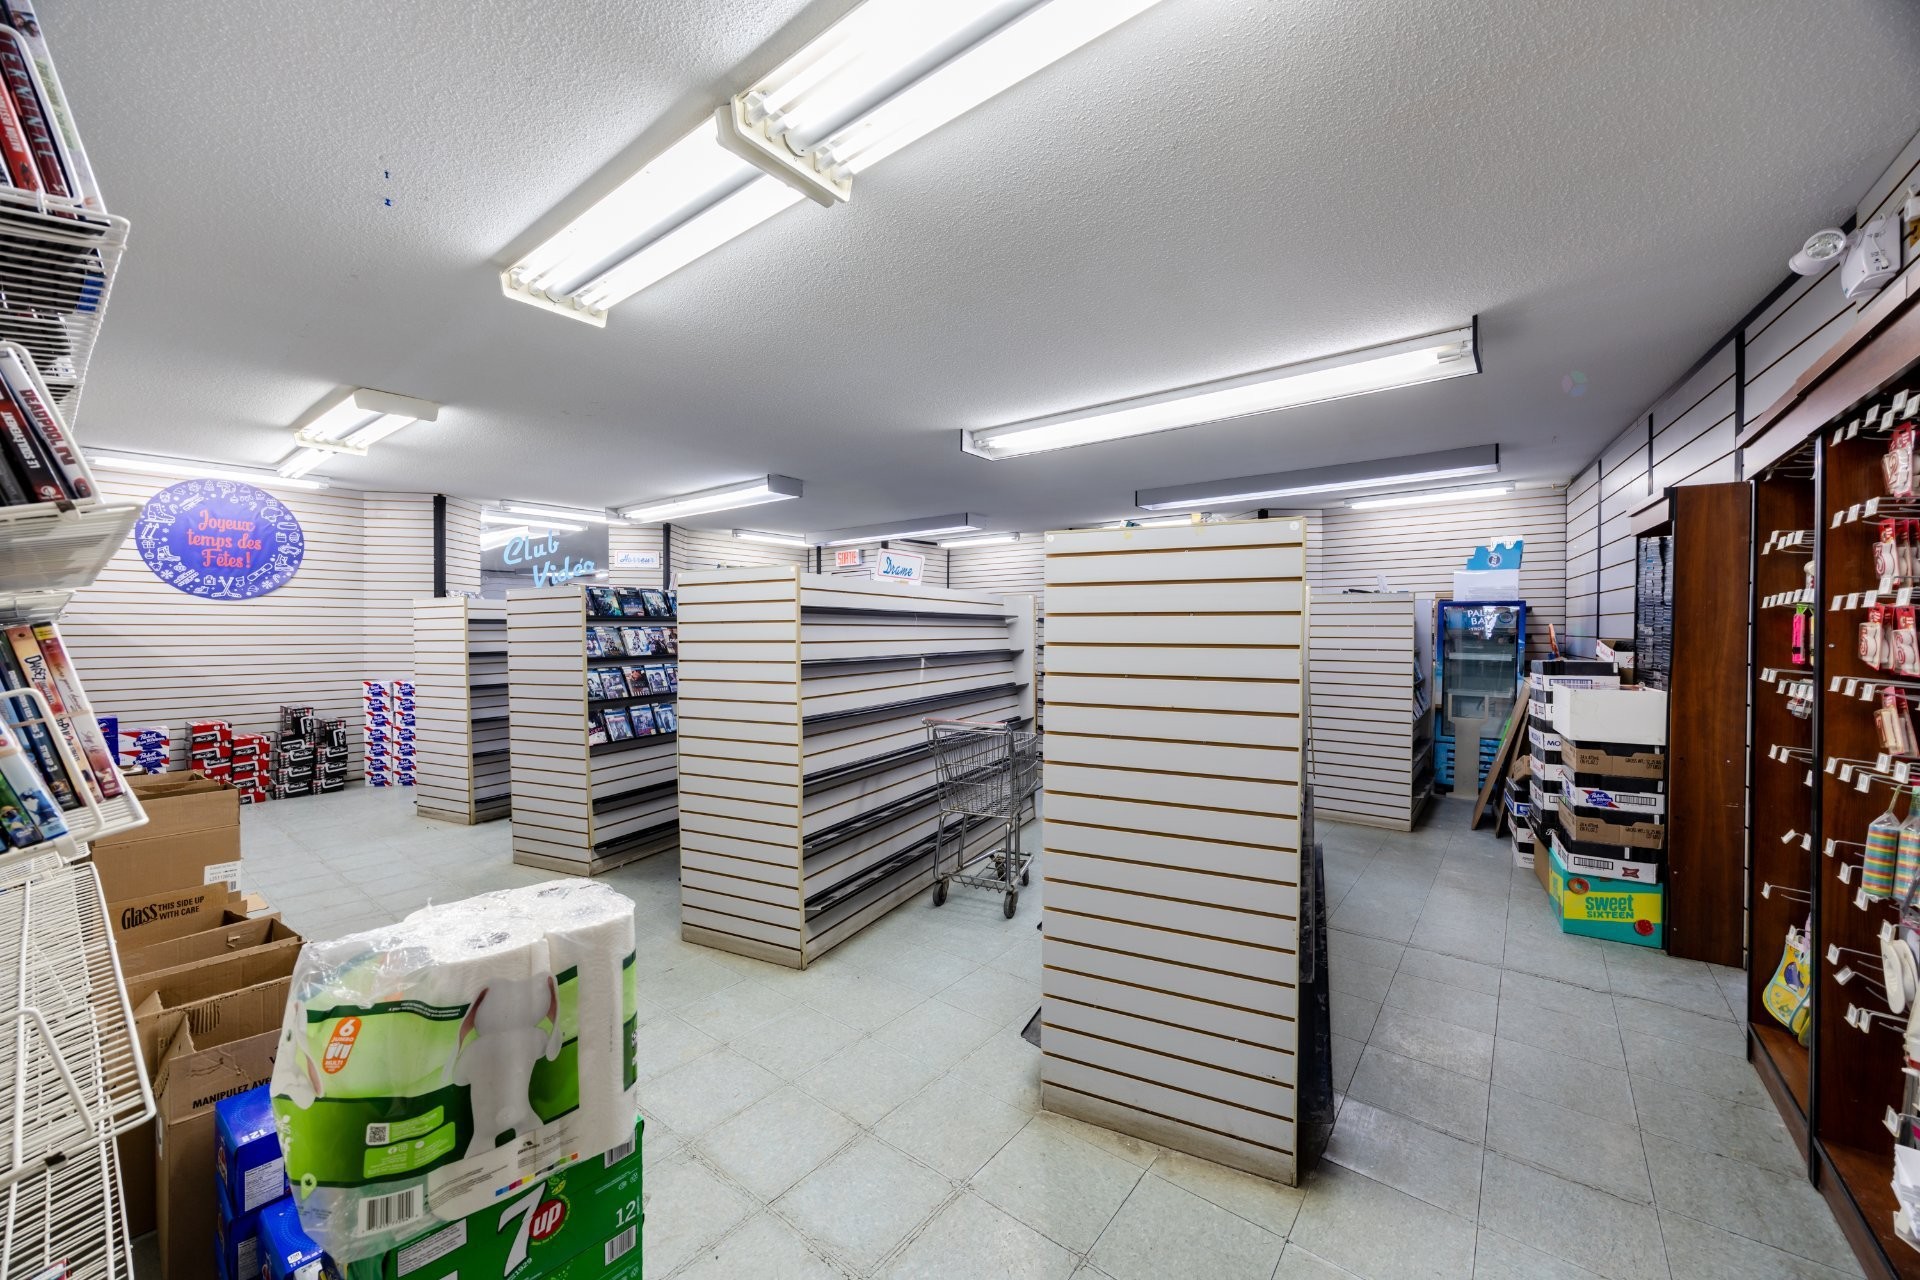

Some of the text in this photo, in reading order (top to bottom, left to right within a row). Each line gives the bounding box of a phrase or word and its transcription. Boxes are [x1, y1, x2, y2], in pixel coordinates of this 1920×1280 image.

[20, 389, 76, 465] DEADPOOL 2
[198, 509, 256, 533] Joyeux
[187, 529, 262, 552] temps des
[503, 528, 560, 565] Club
[202, 549, 243, 568] Fêtes
[837, 551, 857, 565] SORTIE
[883, 556, 913, 577] Drame
[532, 556, 596, 588] Vidéo
[1471, 617, 1493, 625] BAY
[158, 895, 205, 911] THIS SIDE UP
[160, 905, 200, 920] WITH CARE
[1585, 894, 1634, 911] sweet
[1587, 911, 1634, 919] SIXTEEN
[339, 1019, 355, 1036] 6
[192, 1077, 272, 1109] MANIPULEZ AVE
[615, 1200, 636, 1228] 12
[514, 1257, 533, 1277] 1929
